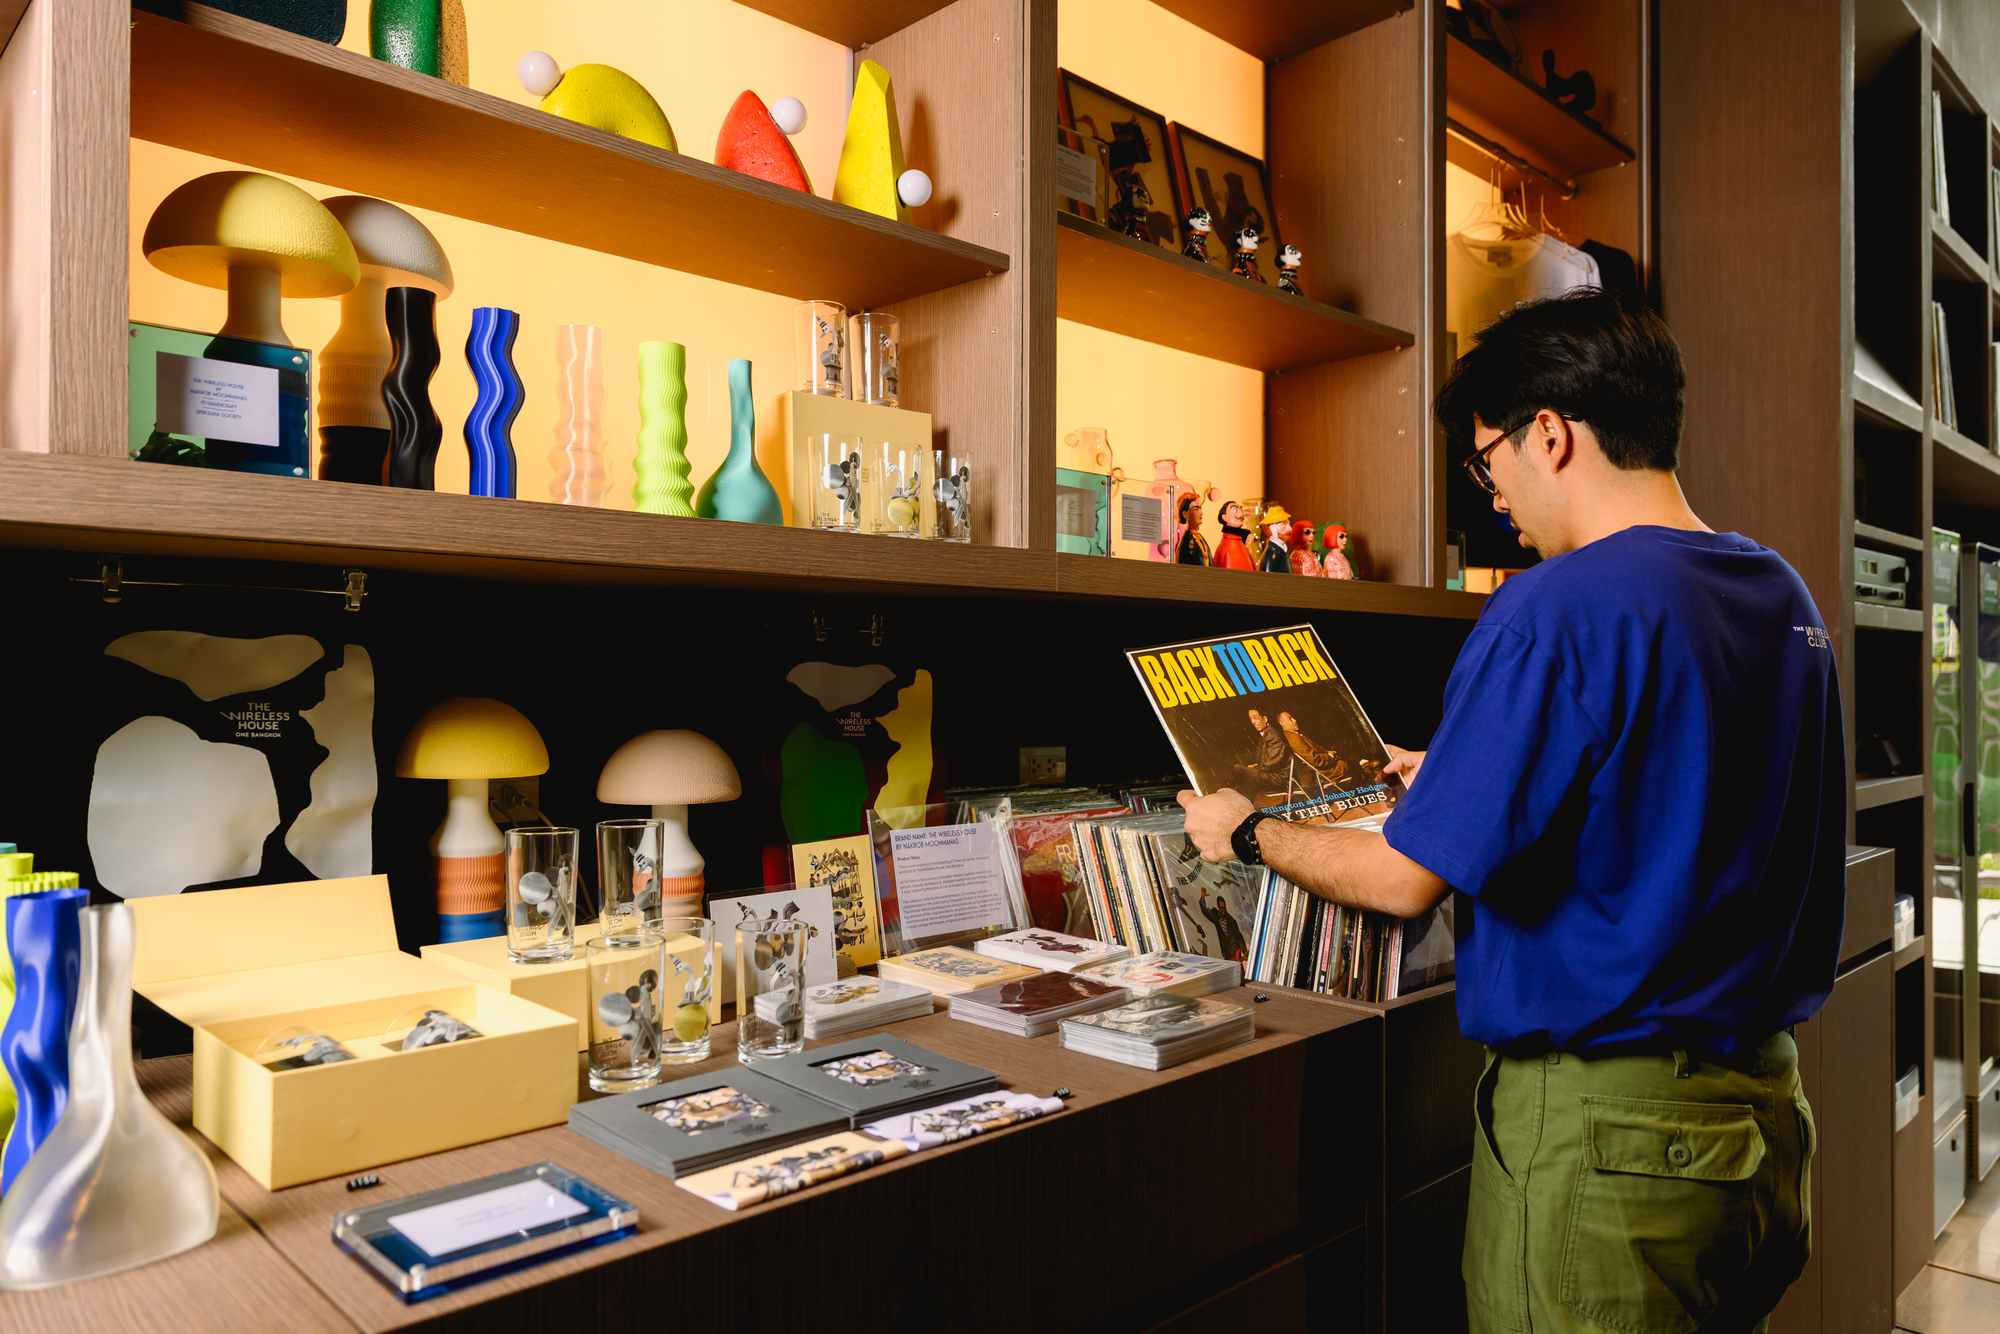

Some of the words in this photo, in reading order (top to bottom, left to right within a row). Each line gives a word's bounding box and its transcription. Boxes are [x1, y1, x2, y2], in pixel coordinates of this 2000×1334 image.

[1808, 637, 1827, 649] CLUB
[247, 703, 271, 711] THE
[220, 711, 290, 721] WIRELESS
[238, 721, 279, 730] HOUSE
[1260, 800, 1305, 814] Ellington
[1306, 796, 1323, 805] and
[1324, 790, 1355, 804] Johnny
[1356, 782, 1389, 794] Hodges
[1296, 804, 1332, 820] THE
[1334, 791, 1388, 811] BLUES
[894, 834, 912, 842] BRAND
[938, 830, 960, 838] WIRELESS
[903, 842, 924, 850] NAKROB
[925, 838, 959, 848] MOONMANAS
